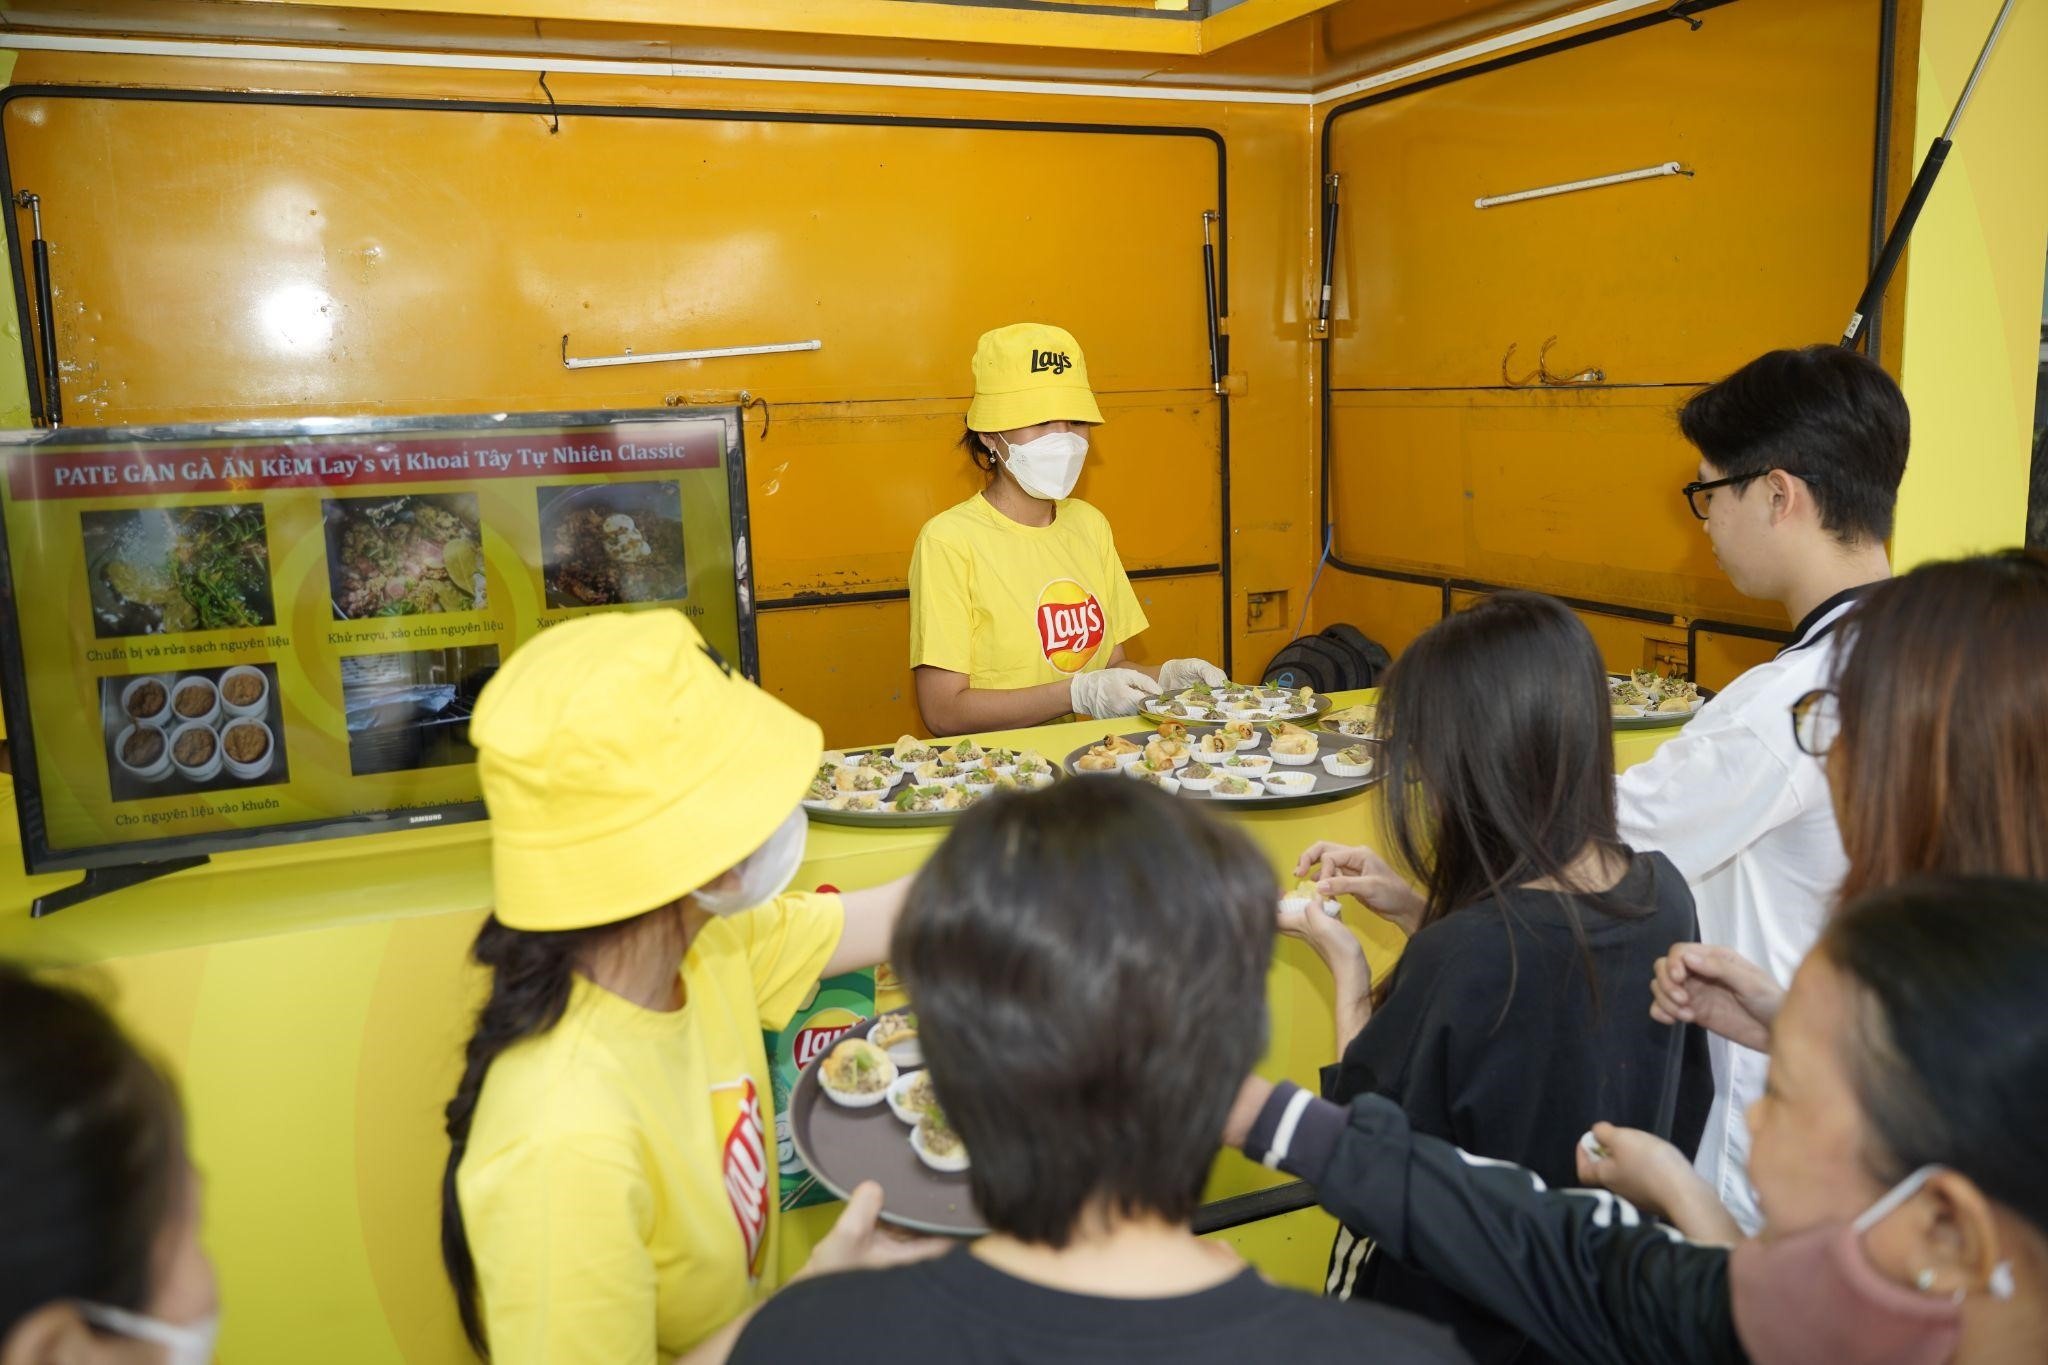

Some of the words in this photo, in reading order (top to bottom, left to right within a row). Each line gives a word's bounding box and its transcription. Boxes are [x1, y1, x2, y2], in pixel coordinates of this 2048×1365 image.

[1030, 349, 1072, 375] Lay's
[54, 465, 118, 486] PATE
[123, 463, 176, 483] GAN
[181, 457, 216, 481] GÀ
[221, 456, 255, 479] ĂN
[261, 454, 314, 478] KÈM
[320, 454, 376, 479] Lay's
[381, 453, 400, 475] vị
[406, 451, 470, 471] Khoai
[474, 449, 512, 471] Tây
[517, 447, 548, 469] Tự
[553, 444, 613, 464] Nhiên
[618, 443, 686, 461] Classic
[391, 625, 411, 640] xào
[413, 624, 438, 637] chín
[441, 623, 481, 637] nguyên
[483, 620, 504, 633] liệu
[1042, 599, 1101, 653] Lay's
[130, 647, 143, 660] bị
[147, 644, 161, 656] và
[190, 642, 218, 654] sạch
[220, 638, 265, 654] nguyên
[267, 635, 291, 649] liệu
[115, 812, 140, 826] Cho
[143, 807, 188, 824] nguyên
[191, 805, 215, 818] liệu
[218, 802, 239, 814] vào
[241, 798, 280, 812] khuôn
[410, 813, 442, 824] SAMSUNG
